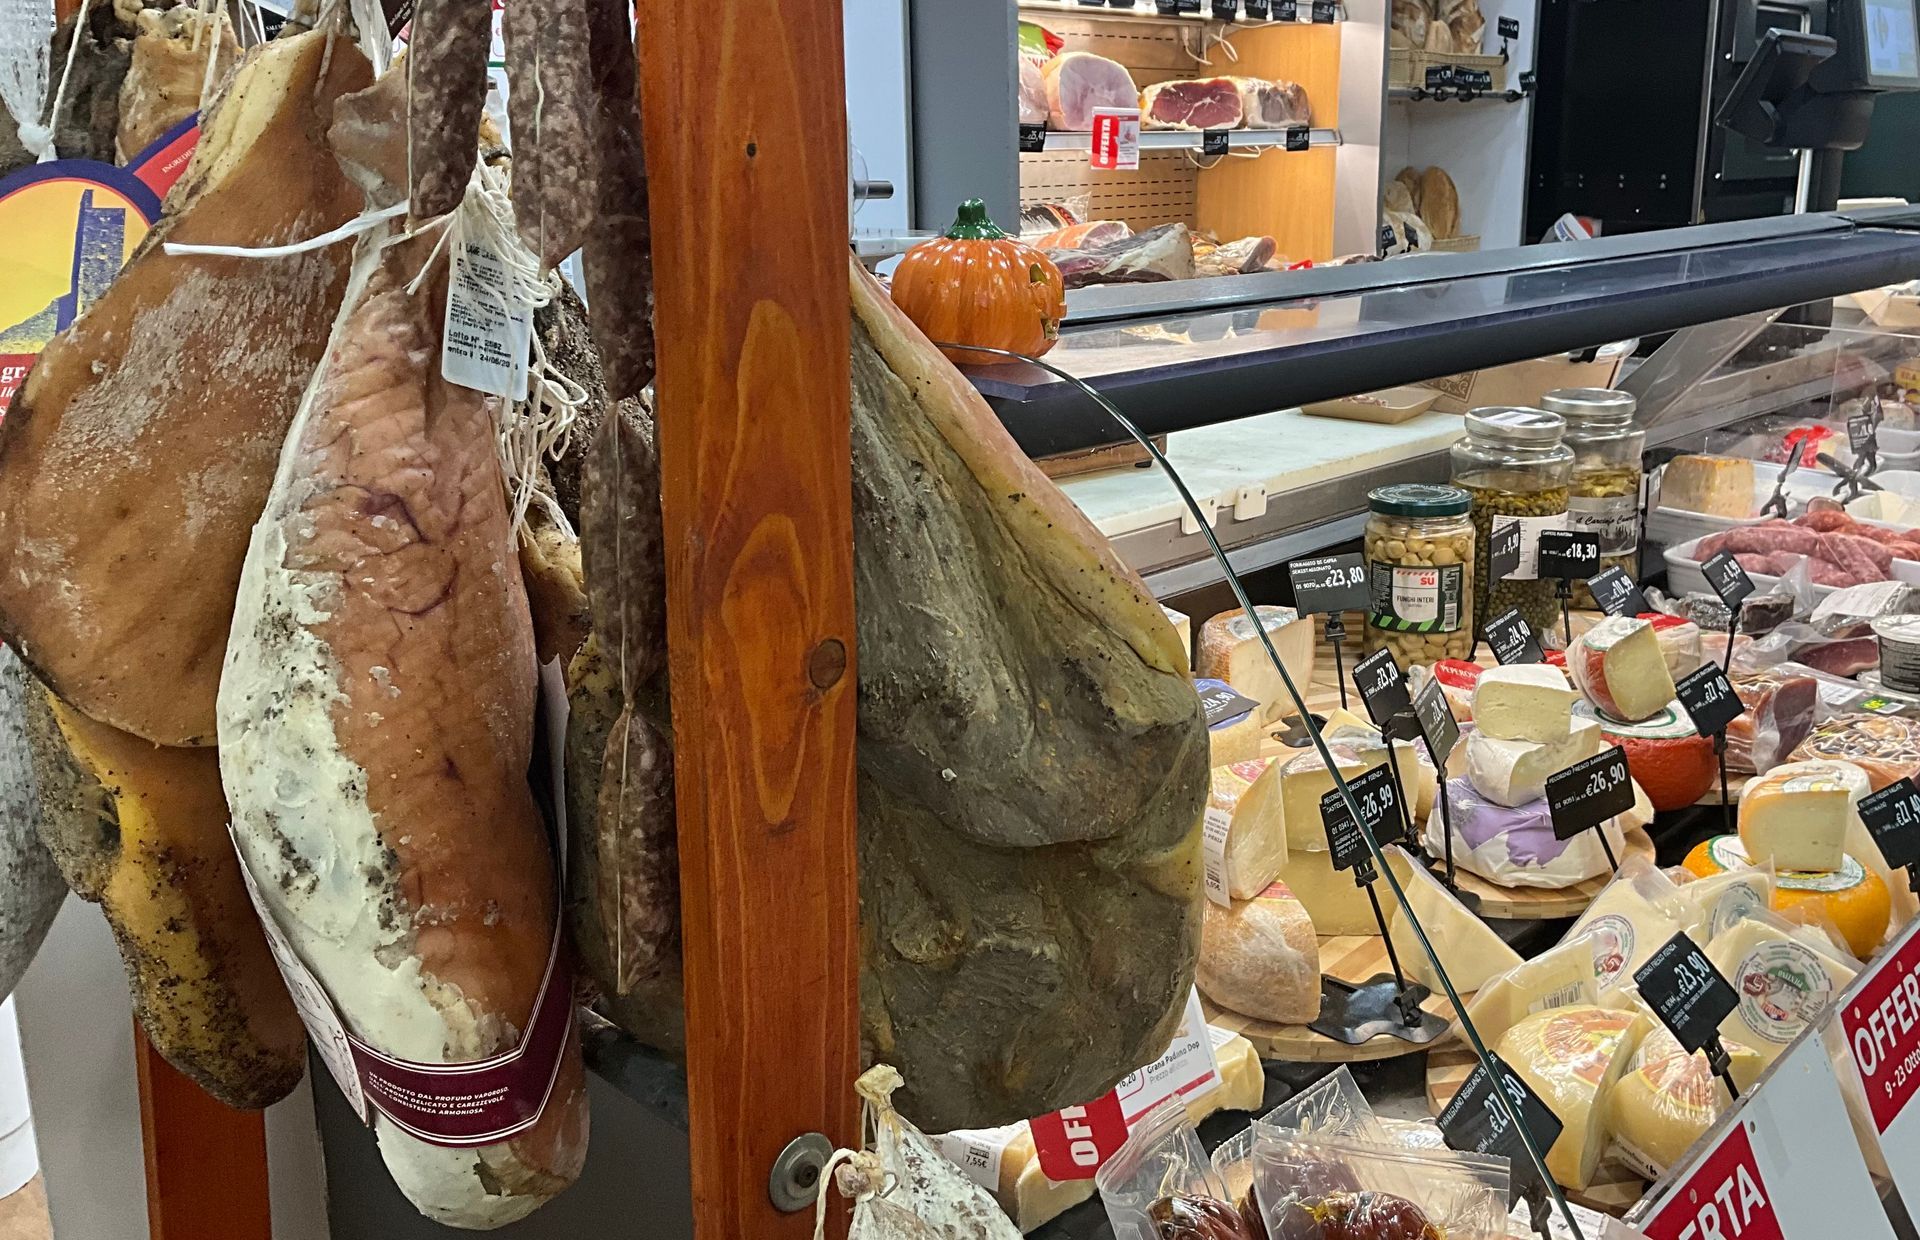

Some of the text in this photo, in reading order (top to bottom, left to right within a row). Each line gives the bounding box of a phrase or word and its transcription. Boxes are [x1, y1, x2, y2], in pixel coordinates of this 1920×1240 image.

[1100, 118, 1111, 164] OFFERTA
[448, 330, 470, 340] Lotto
[1290, 560, 1316, 568] FORMAGGIO
[1566, 542, 1597, 562] €18,30
[1326, 566, 1364, 589] €23,80
[1397, 595, 1416, 603] FUNGHI
[1508, 620, 1531, 646] €24,40
[1376, 660, 1399, 690] €23,20
[1704, 675, 1729, 703] €27,40
[1549, 769, 1572, 783] PECORINO
[1572, 761, 1590, 773] FRESCO
[1586, 762, 1625, 796] €26,90
[1324, 770, 1383, 805] PECORIN EMISTAG PIENZA
[1360, 784, 1393, 820] €26,99
[1674, 951, 1710, 994] €23,90
[1854, 962, 1920, 1077] OFFER
[1147, 1041, 1200, 1074] Grana Padano Dop
[379, 1077, 416, 1096] PRODOTTO
[1149, 1070, 1168, 1084] Prezzo
[1885, 1081, 1893, 1099] 9
[1895, 1065, 1906, 1087] 23
[369, 1080, 388, 1096] DALLA
[388, 1094, 436, 1115] CONSISTENZA
[410, 1097, 448, 1108] DELICATO
[1440, 1096, 1464, 1129] PARMIGIANO
[1460, 1073, 1481, 1100] REGGIANO
[966, 1154, 987, 1168] 7,55€
